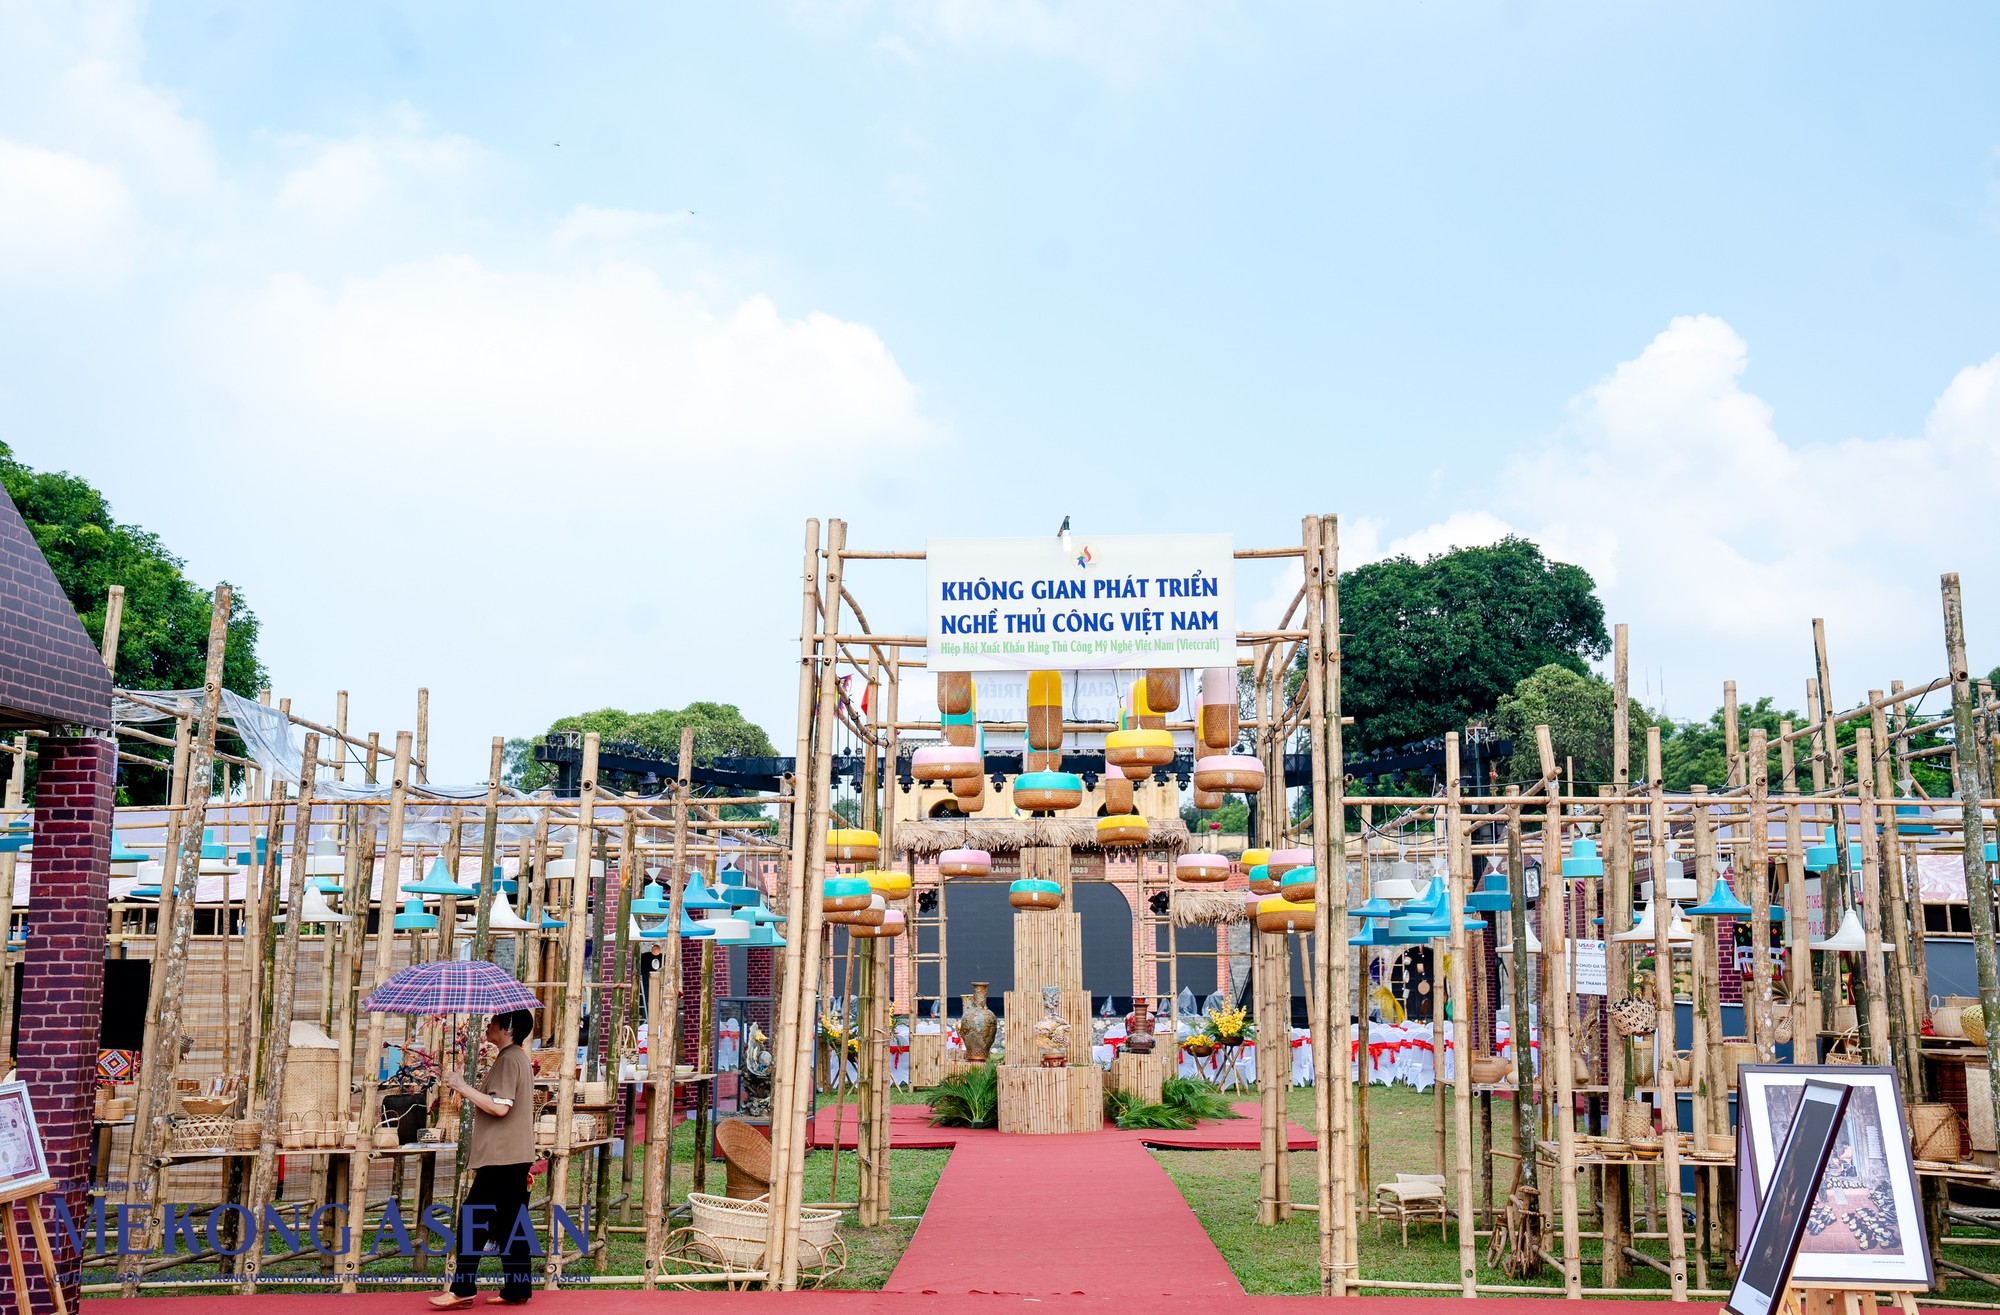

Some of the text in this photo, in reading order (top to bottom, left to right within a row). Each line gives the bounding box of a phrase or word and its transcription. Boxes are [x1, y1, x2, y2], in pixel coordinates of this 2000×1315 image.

[941, 569, 1219, 601] KHÔNG GIAN PHÁT TRIỂN
[941, 606, 1219, 636] NGHỀ THỦ CÔNG VIỆT NAM
[940, 637, 1220, 657] Hiệp Hội Xuất Khẩu Hàng Thủ Công Mỹ Nghệ Việt Nam (Vietcraft)
